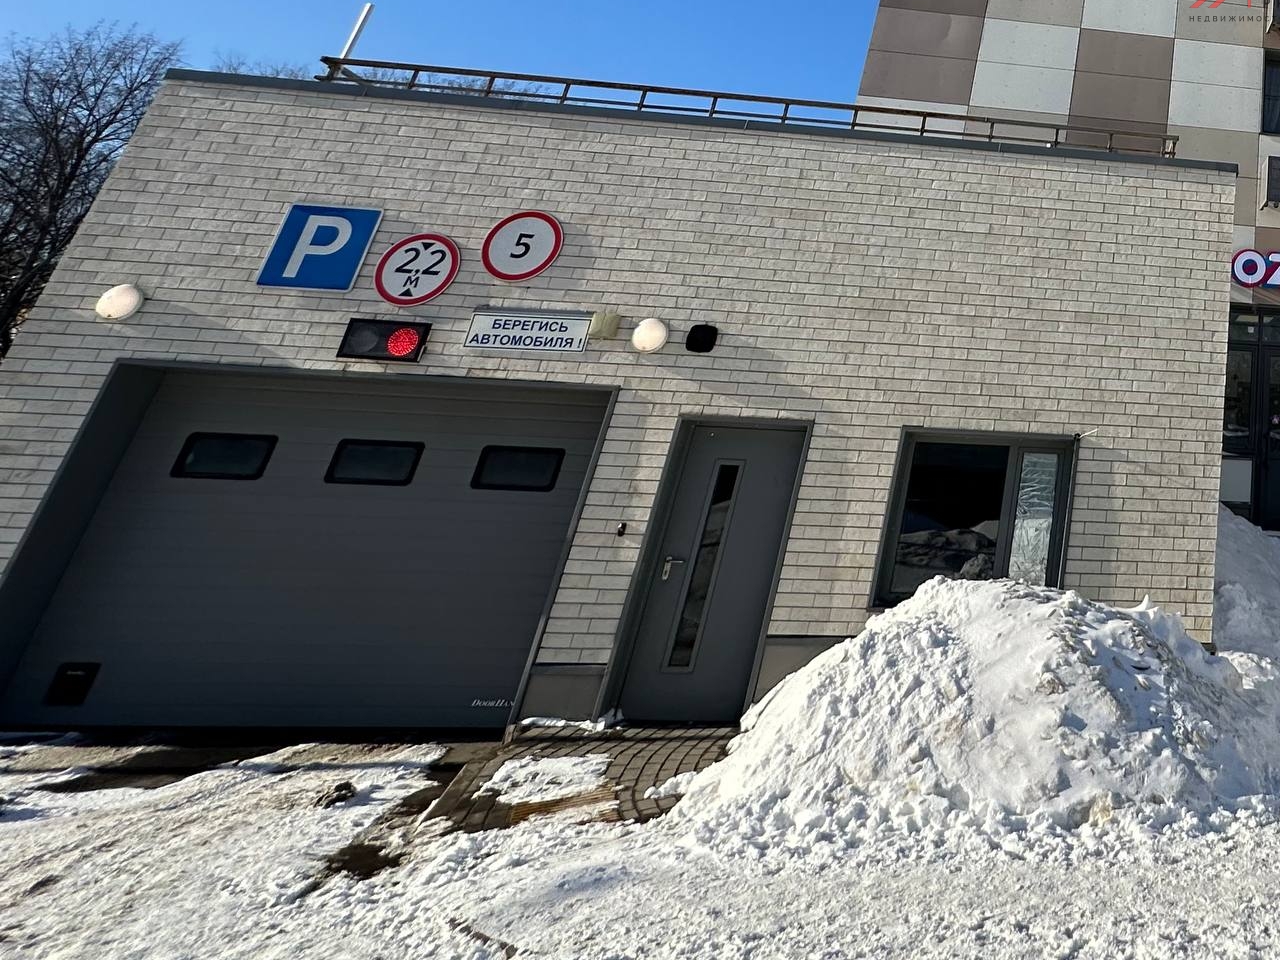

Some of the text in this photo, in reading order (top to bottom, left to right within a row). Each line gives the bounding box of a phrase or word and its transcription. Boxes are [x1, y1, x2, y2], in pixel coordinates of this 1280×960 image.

[509, 233, 535, 258] 5
[394, 247, 447, 277] 2,2
[491, 319, 569, 333] БЕРЕГИСЬ
[468, 333, 574, 349] АВТОМОБИЛЯ
